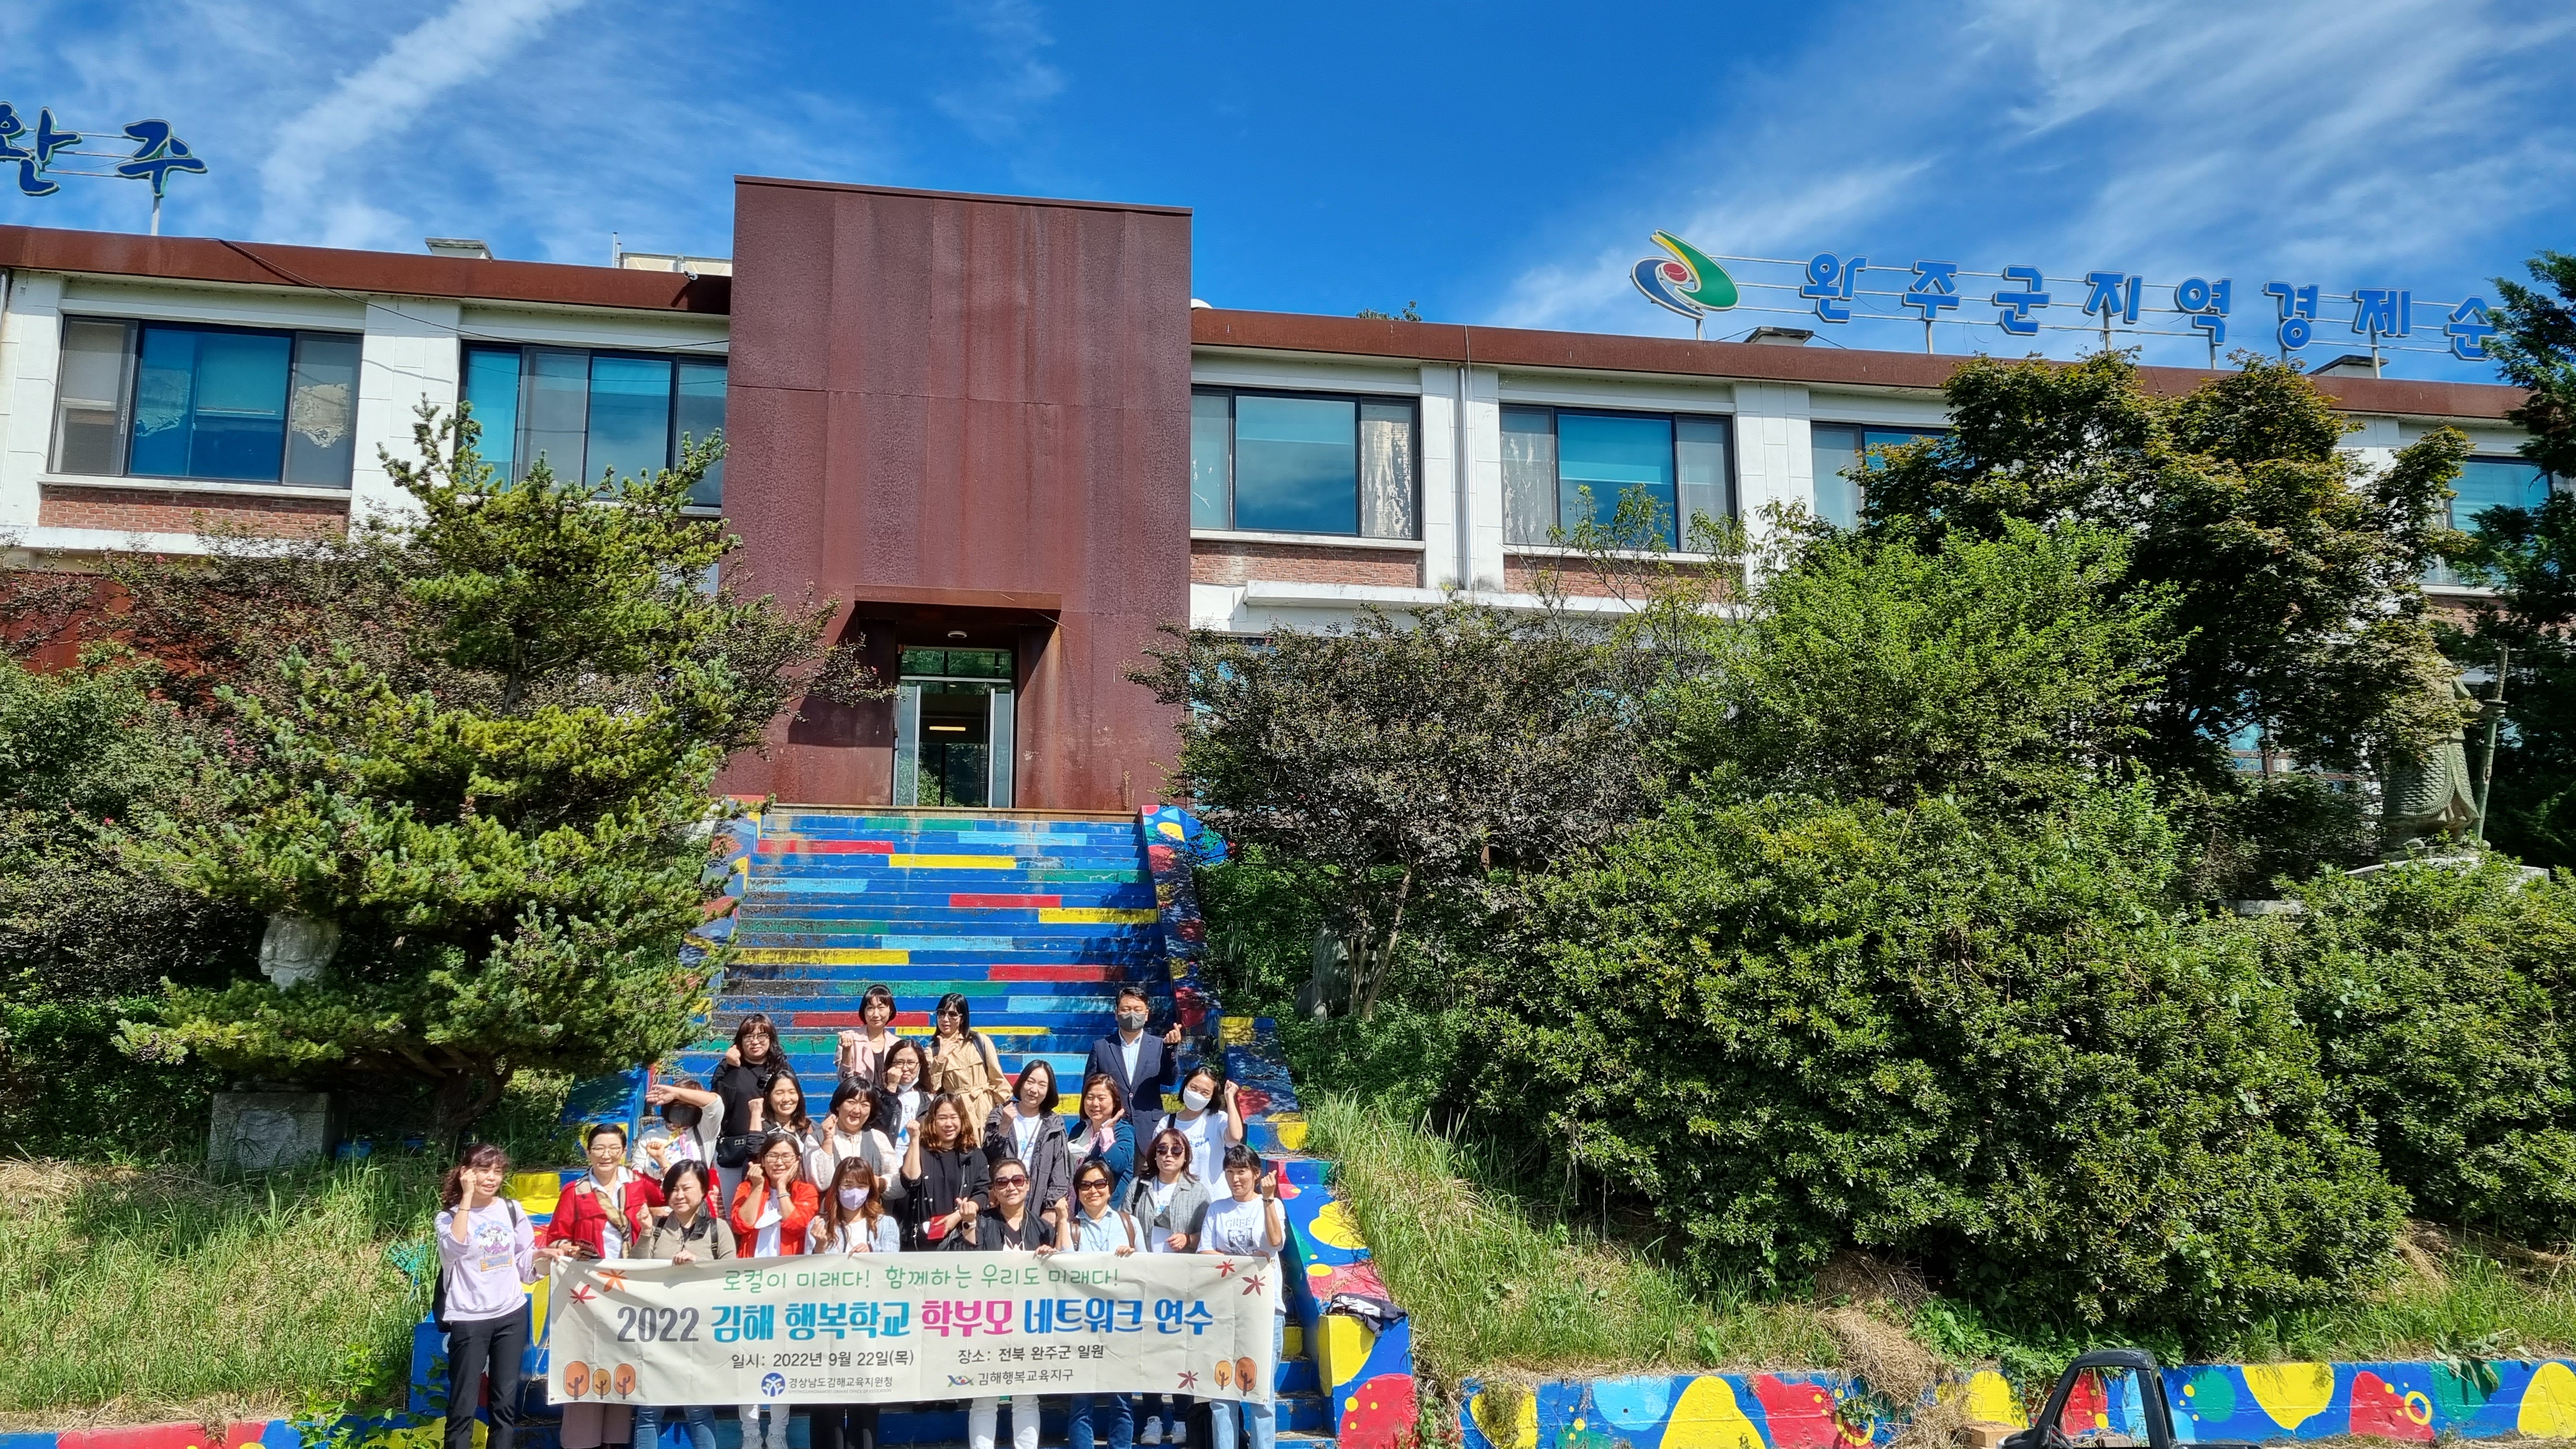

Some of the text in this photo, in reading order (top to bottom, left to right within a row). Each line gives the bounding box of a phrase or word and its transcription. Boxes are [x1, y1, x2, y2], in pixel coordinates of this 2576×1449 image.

[723, 1264, 1119, 1294] 로컬이 미래다! 함께하는 우리도 미래다!
[617, 1298, 1214, 1342] 2022 김해 행복학교 학부모 네트워크 연수
[731, 1349, 914, 1369] 일시: 2022년 9월 22일(목)
[958, 1344, 1104, 1365] 장소: 전북 완주군 일원
[788, 1376, 893, 1389] 경상남도김해교육지원청
[977, 1369, 1074, 1386] 김해행복교육지구
